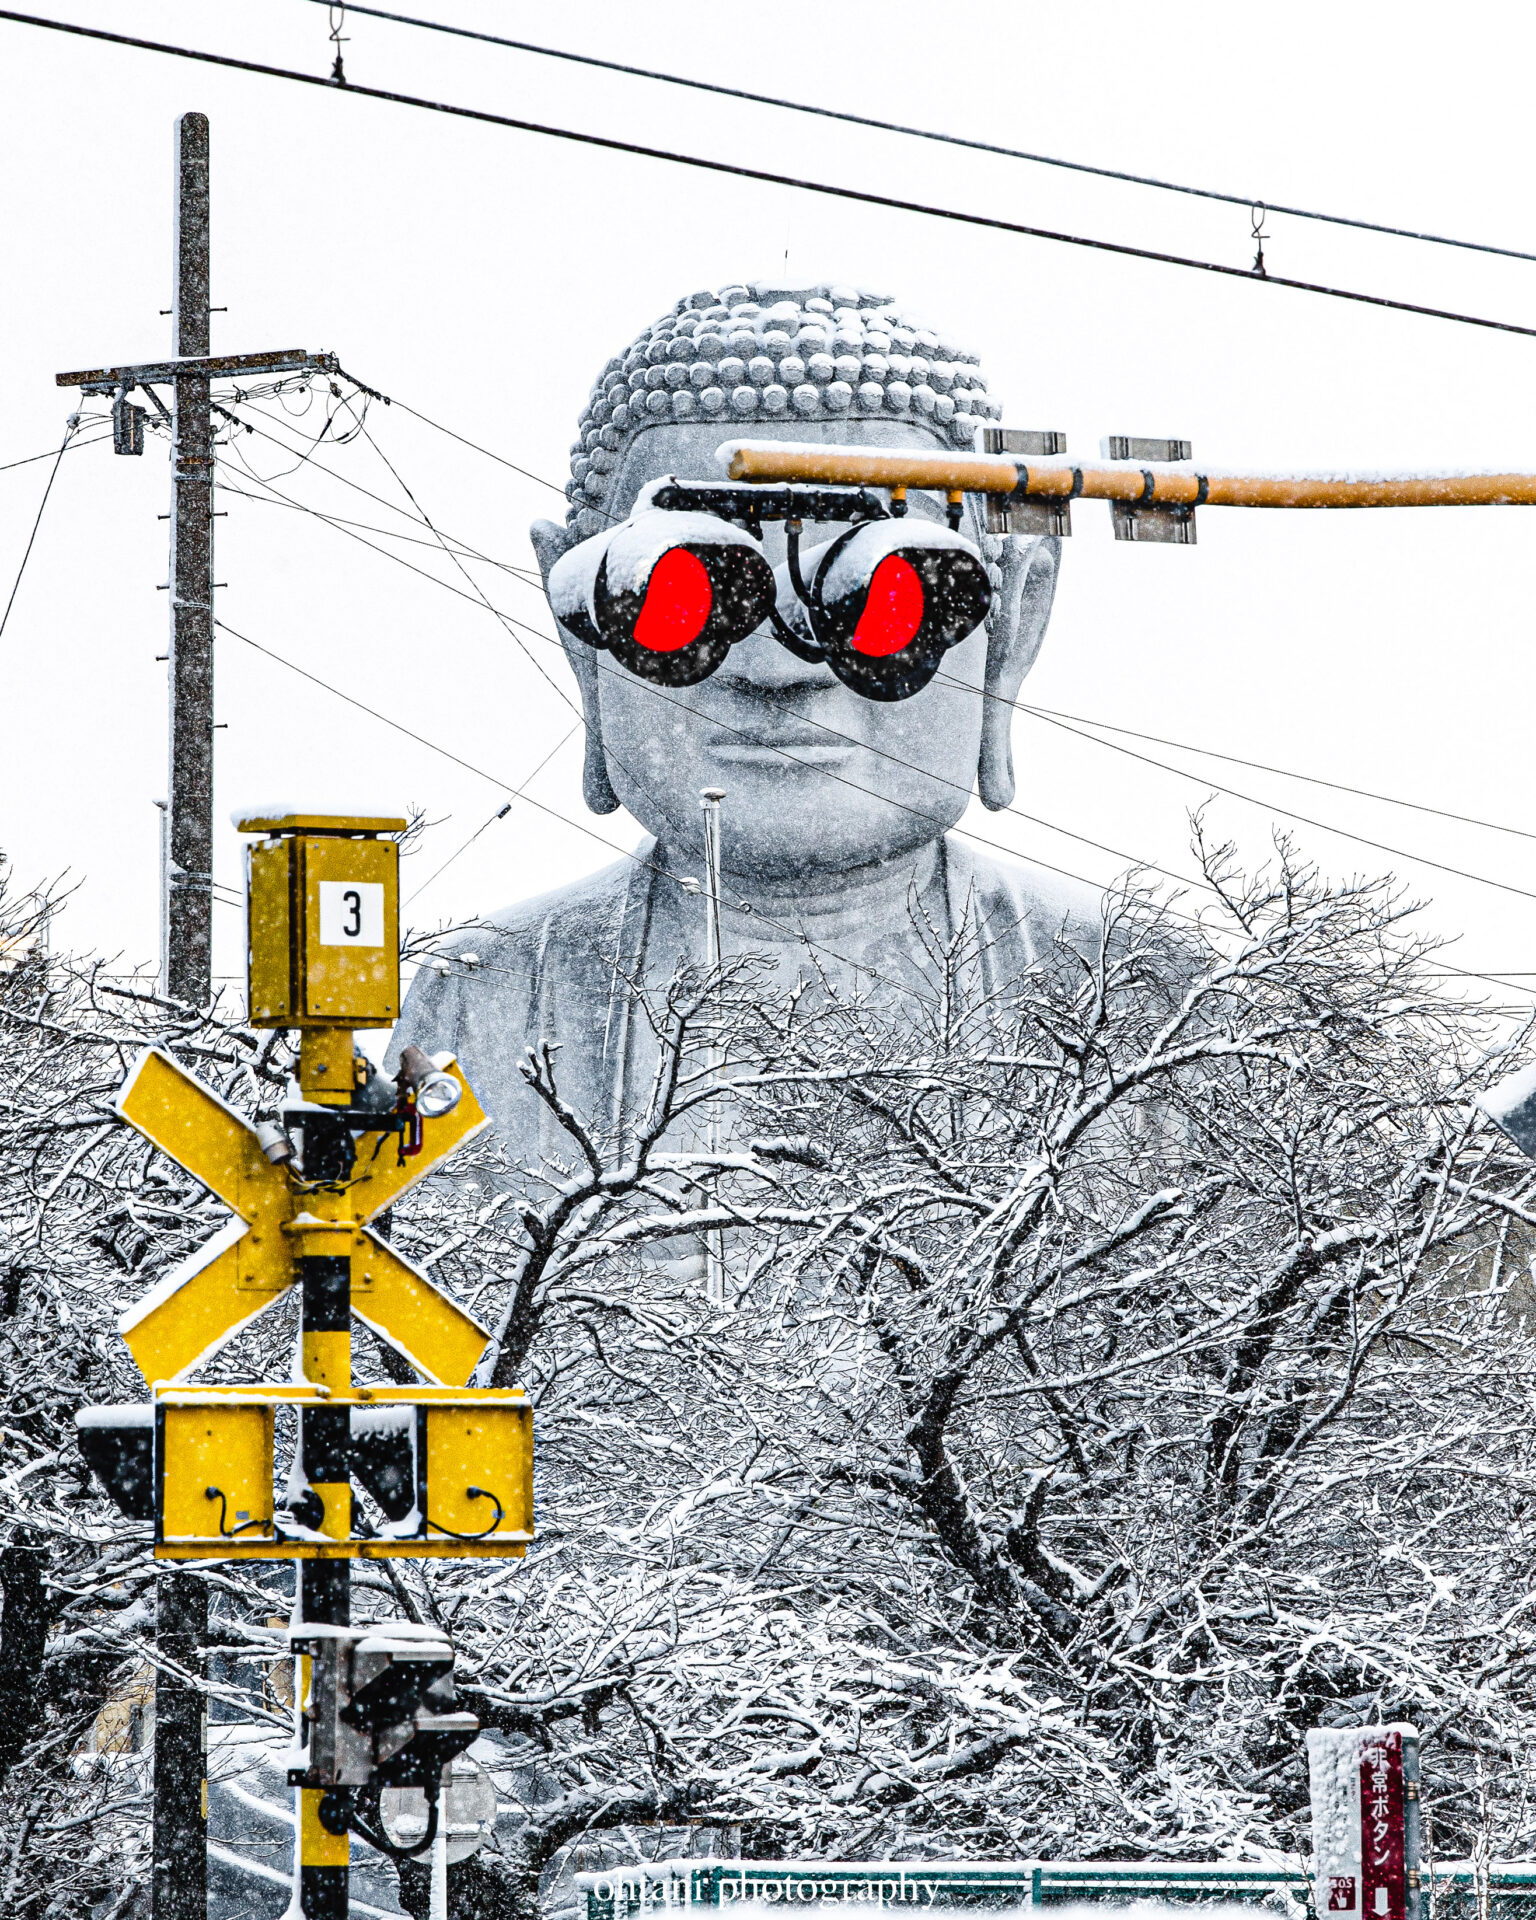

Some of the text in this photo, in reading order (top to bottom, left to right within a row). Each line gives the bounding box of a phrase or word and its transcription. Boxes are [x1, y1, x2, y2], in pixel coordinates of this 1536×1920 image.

[343, 890, 361, 937] 3
[1370, 1747, 1391, 1866] 非常ボタン
